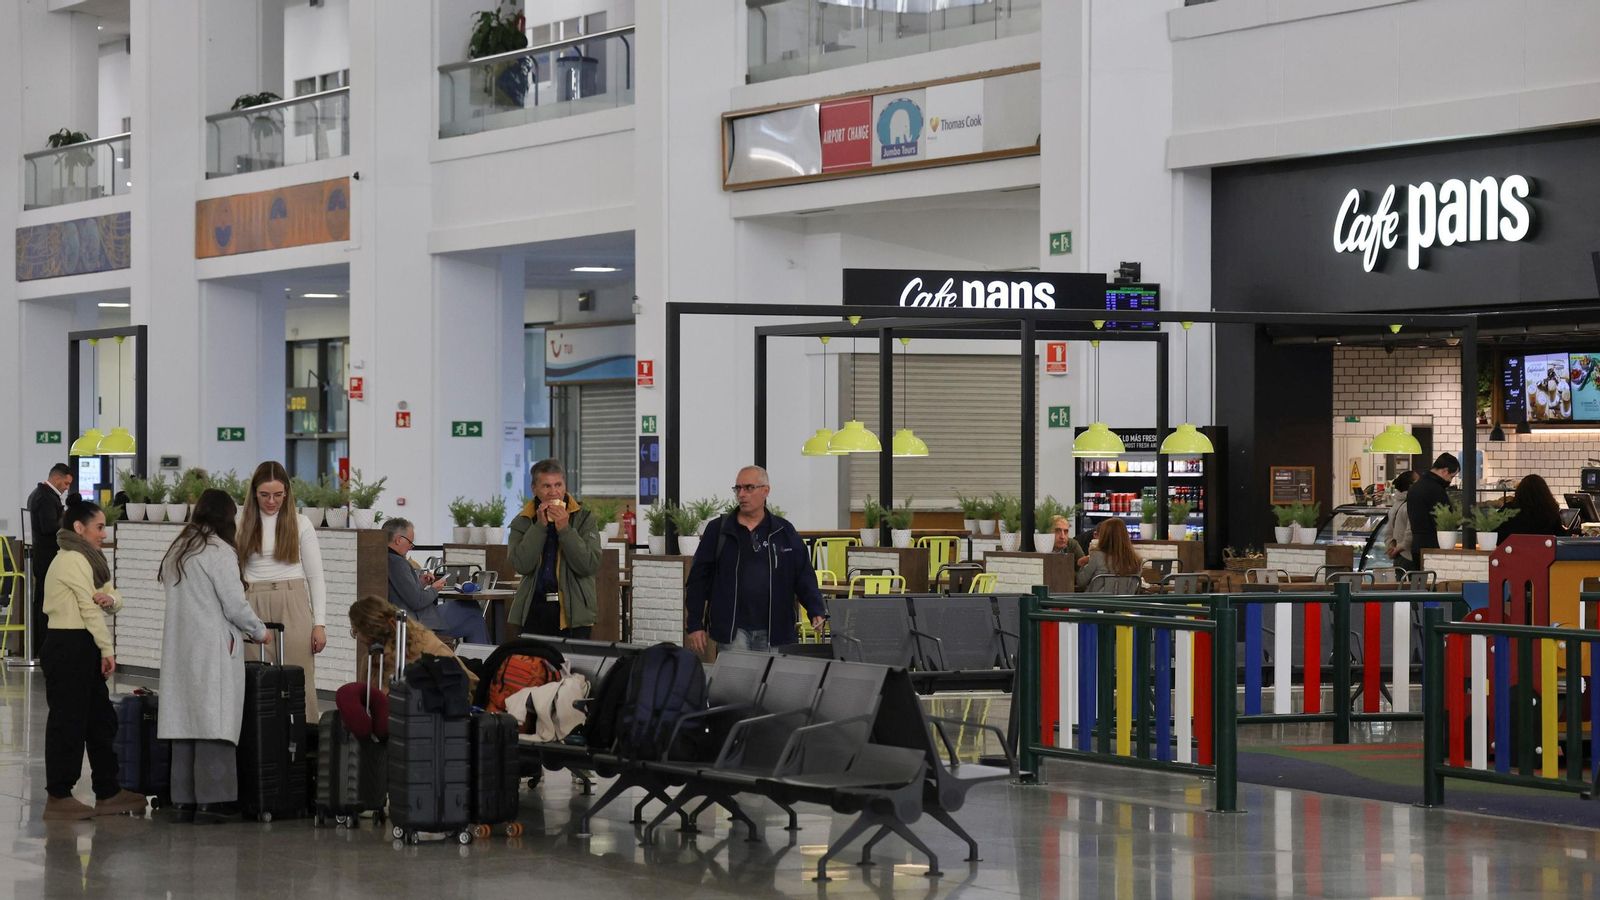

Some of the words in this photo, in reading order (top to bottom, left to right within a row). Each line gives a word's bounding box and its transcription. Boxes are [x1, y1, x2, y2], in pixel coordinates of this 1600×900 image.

[941, 119, 965, 131] Thomas
[965, 115, 982, 128] Cook
[823, 128, 845, 143] AIRPORT
[847, 125, 869, 142] CHANGE
[883, 145, 901, 158] Jumbo
[902, 144, 917, 156] Tours
[1407, 174, 1530, 270] pans
